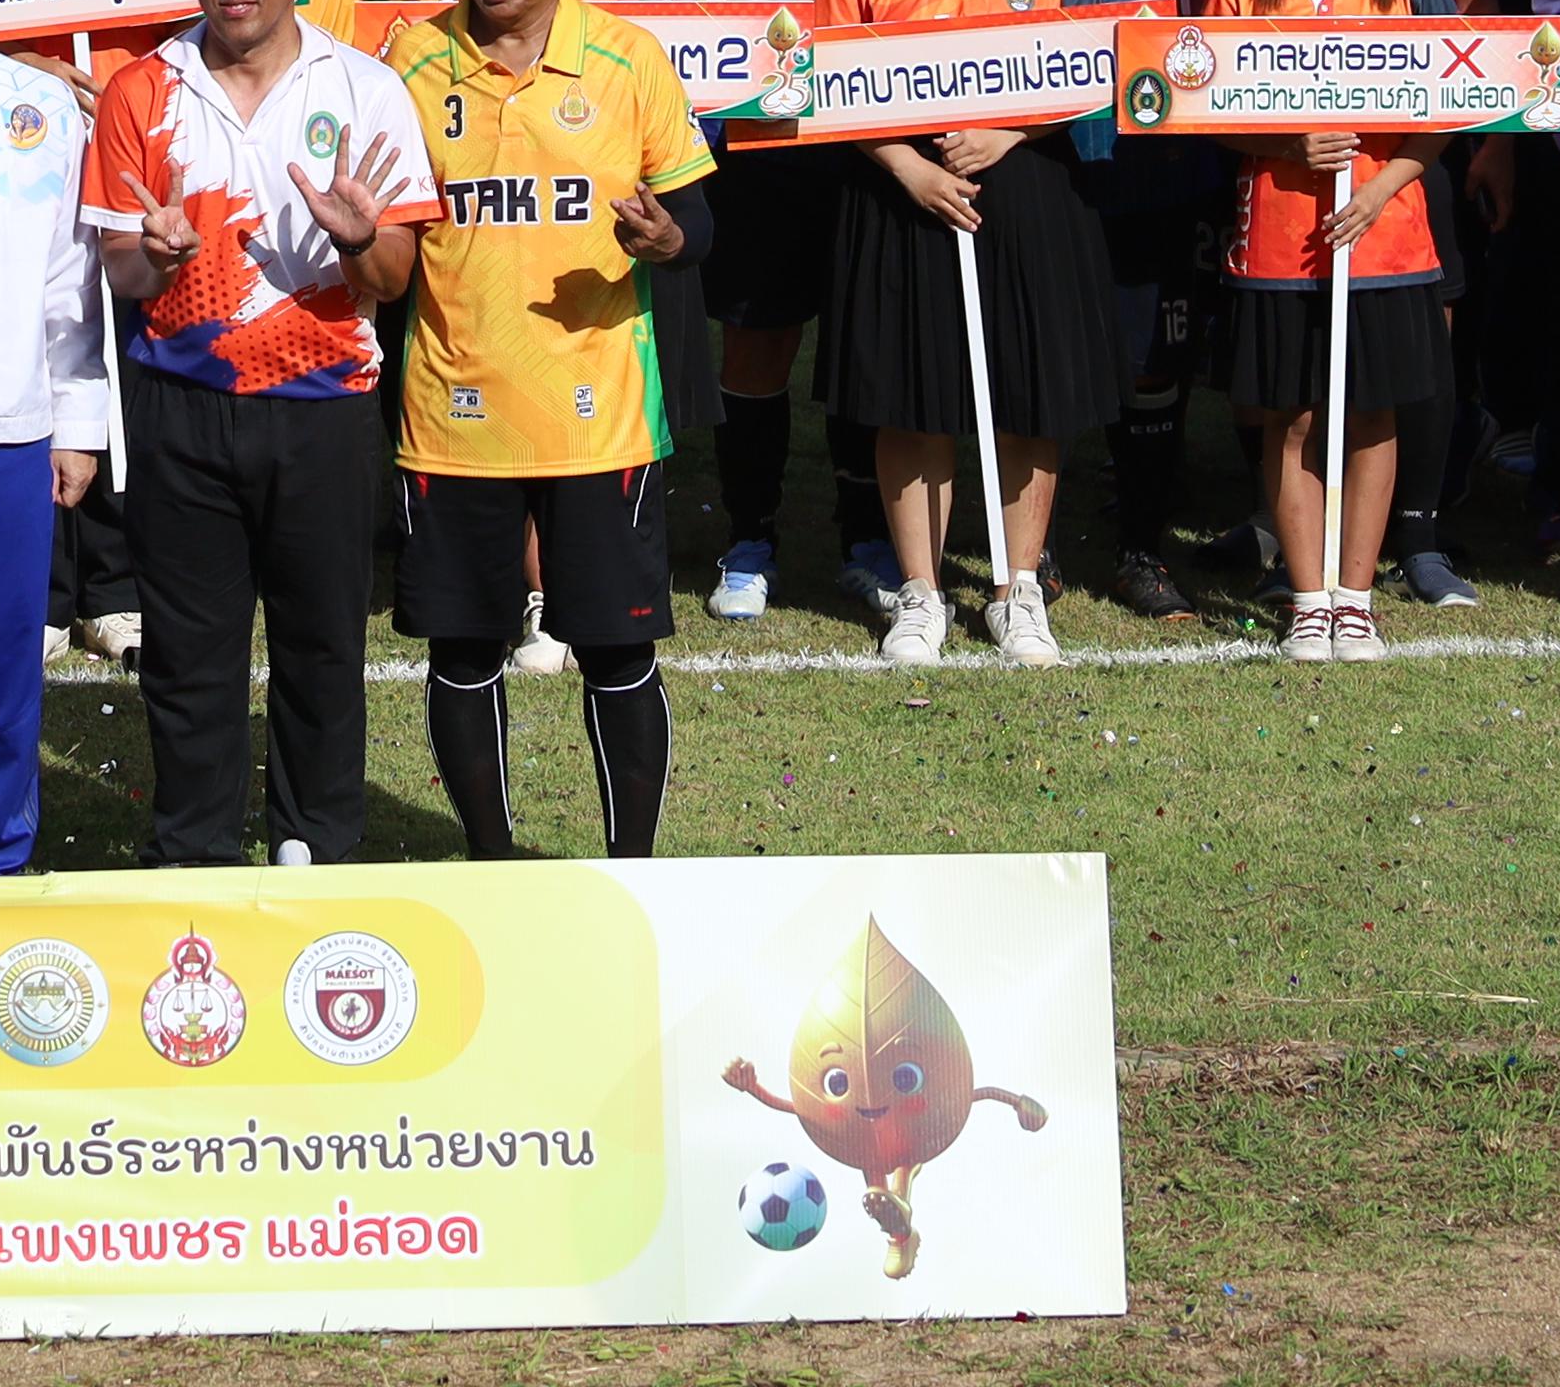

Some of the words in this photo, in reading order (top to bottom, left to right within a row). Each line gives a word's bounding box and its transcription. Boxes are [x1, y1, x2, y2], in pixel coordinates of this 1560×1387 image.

[716, 36, 751, 82] 2
[815, 40, 1117, 110] เทศบาลนครแม่สอด
[1236, 35, 1432, 82] ศาลยุติธรรม
[444, 94, 464, 139] 3
[1209, 80, 1429, 117] มหาวิทยาลัยราชภัฏ
[1440, 78, 1517, 110] แม่สอด
[444, 176, 540, 227] TAK
[551, 175, 592, 225] 2
[1130, 421, 1173, 435] EGO
[325, 970, 376, 980] MAESOT
[267, 1199, 480, 1259] แม่สอด
